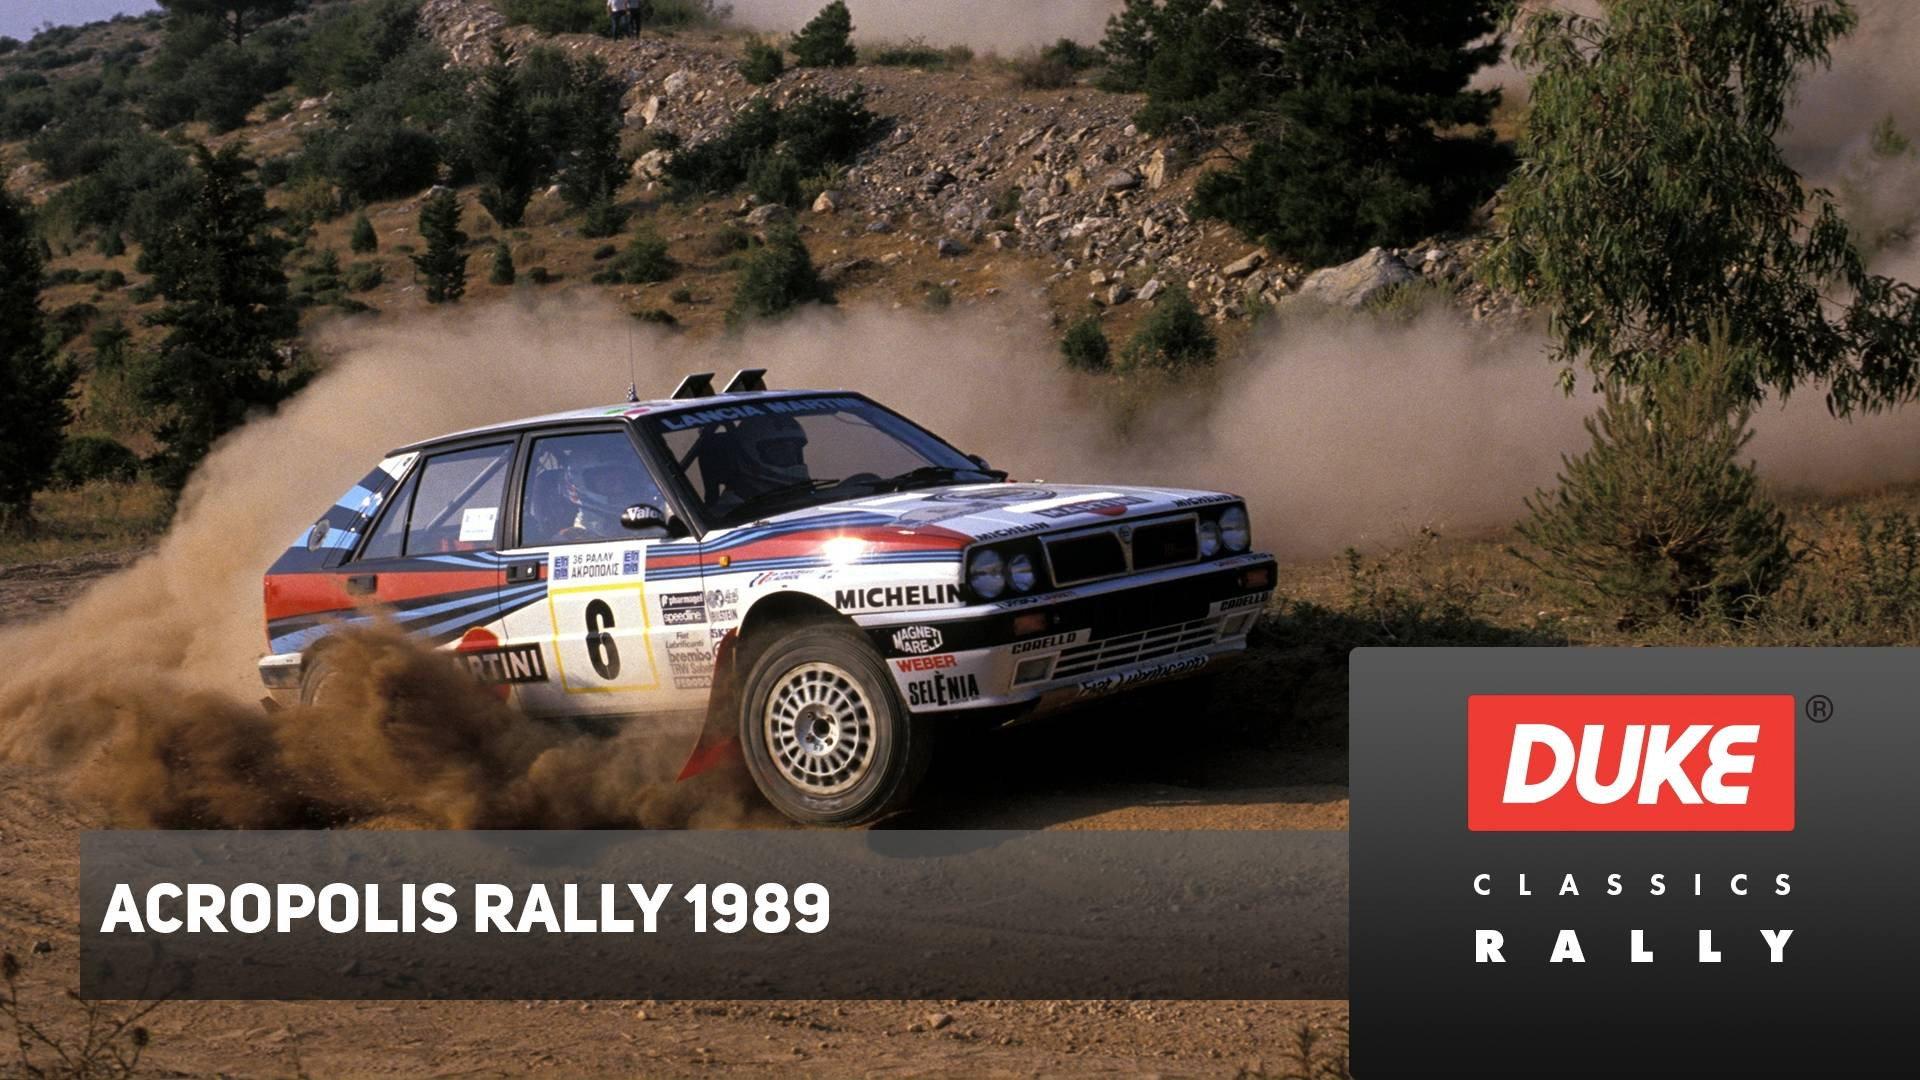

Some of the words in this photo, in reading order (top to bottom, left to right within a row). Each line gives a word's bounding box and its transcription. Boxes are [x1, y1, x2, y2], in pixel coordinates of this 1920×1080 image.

[661, 403, 766, 430] LANCIA
[1171, 494, 1232, 508] MICHELIN
[975, 522, 1051, 541] MICHELIN
[834, 583, 966, 610] MICHELIN
[585, 598, 621, 681] 6
[1011, 632, 1077, 654] CARELLO
[667, 648, 712, 662] brembo
[896, 655, 957, 673] WEBER
